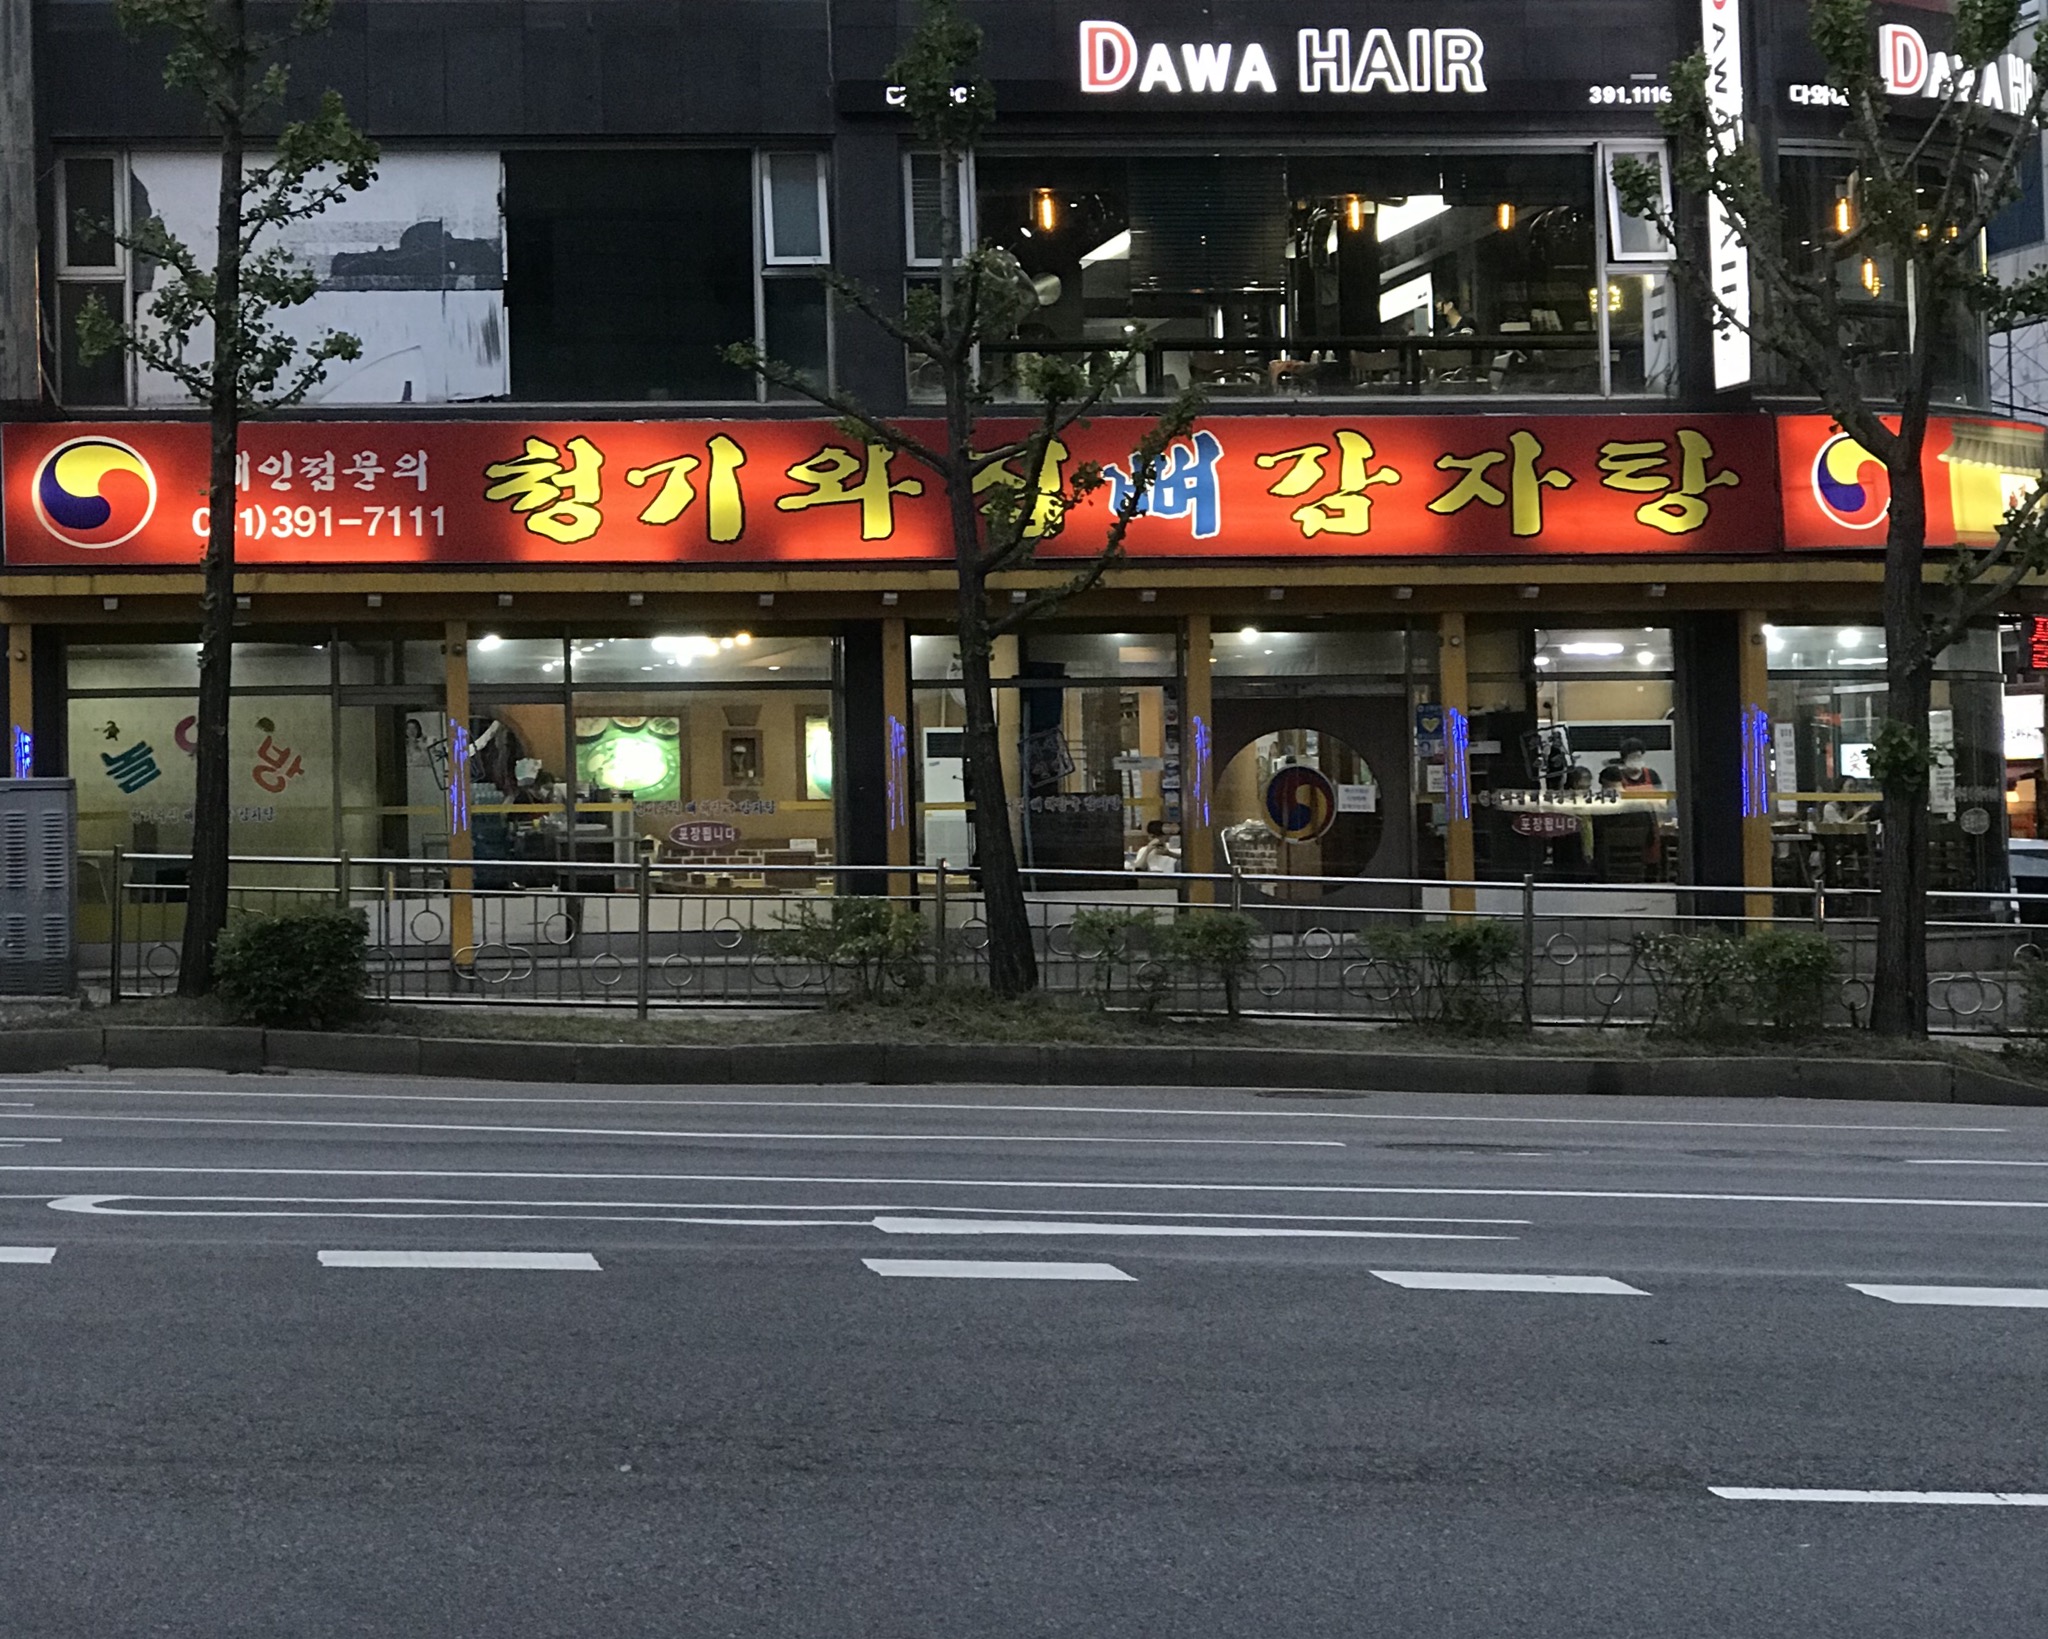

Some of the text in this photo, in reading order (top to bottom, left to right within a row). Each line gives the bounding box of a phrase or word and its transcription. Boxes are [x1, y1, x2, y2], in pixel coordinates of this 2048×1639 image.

[1079, 19, 1487, 94] DAWA HAIR
[1588, 85, 1673, 104] 391.1116
[1255, 429, 1740, 538] 감자탕
[191, 503, 446, 540] 01)391-7111
[100, 715, 306, 795] 놀방
[678, 826, 736, 842] 포장됩니다
